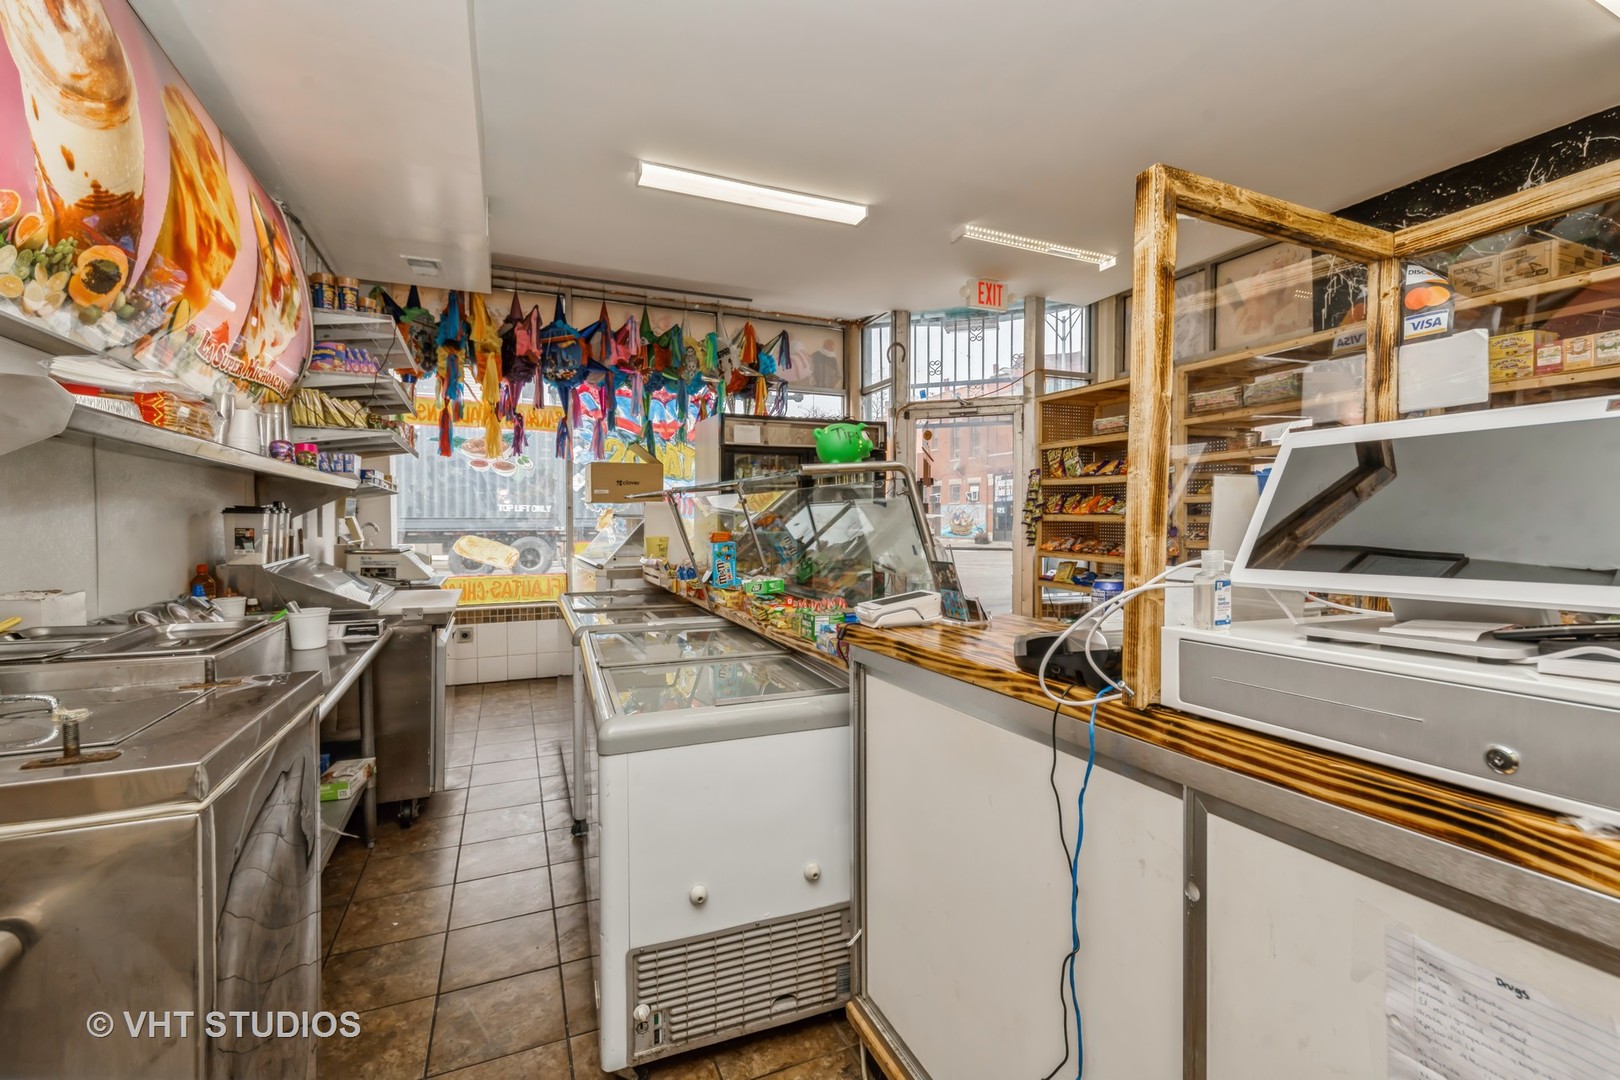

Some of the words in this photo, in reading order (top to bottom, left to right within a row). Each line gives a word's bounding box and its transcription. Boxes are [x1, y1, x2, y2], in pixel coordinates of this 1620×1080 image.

[978, 281, 1003, 307] EXIT
[1411, 317, 1442, 331] VISA
[196, 329, 214, 363] LA
[212, 344, 245, 377] SUPER
[830, 427, 860, 445] Tips
[497, 504, 514, 512] TOP
[514, 504, 531, 512] LIFT
[531, 504, 552, 513] ONLY
